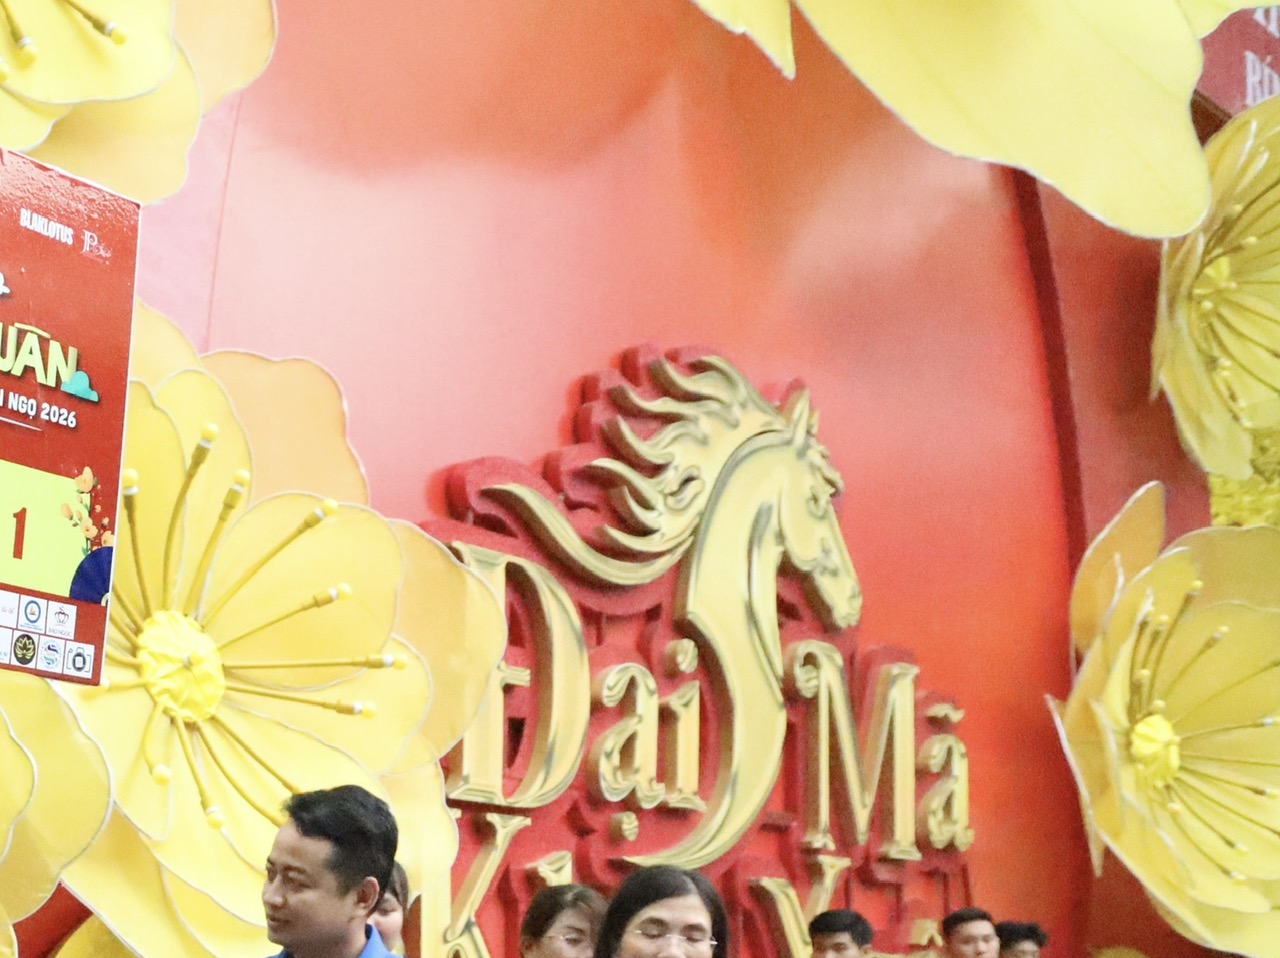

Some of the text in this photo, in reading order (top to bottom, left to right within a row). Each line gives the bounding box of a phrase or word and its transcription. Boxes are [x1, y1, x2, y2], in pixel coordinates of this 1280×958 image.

[20, 208, 74, 245] BLAKLOTUS
[8, 391, 38, 420] NGỌ
[40, 402, 78, 429] 2026
[13, 507, 27, 560] 1
[447, 541, 707, 841] Đại
